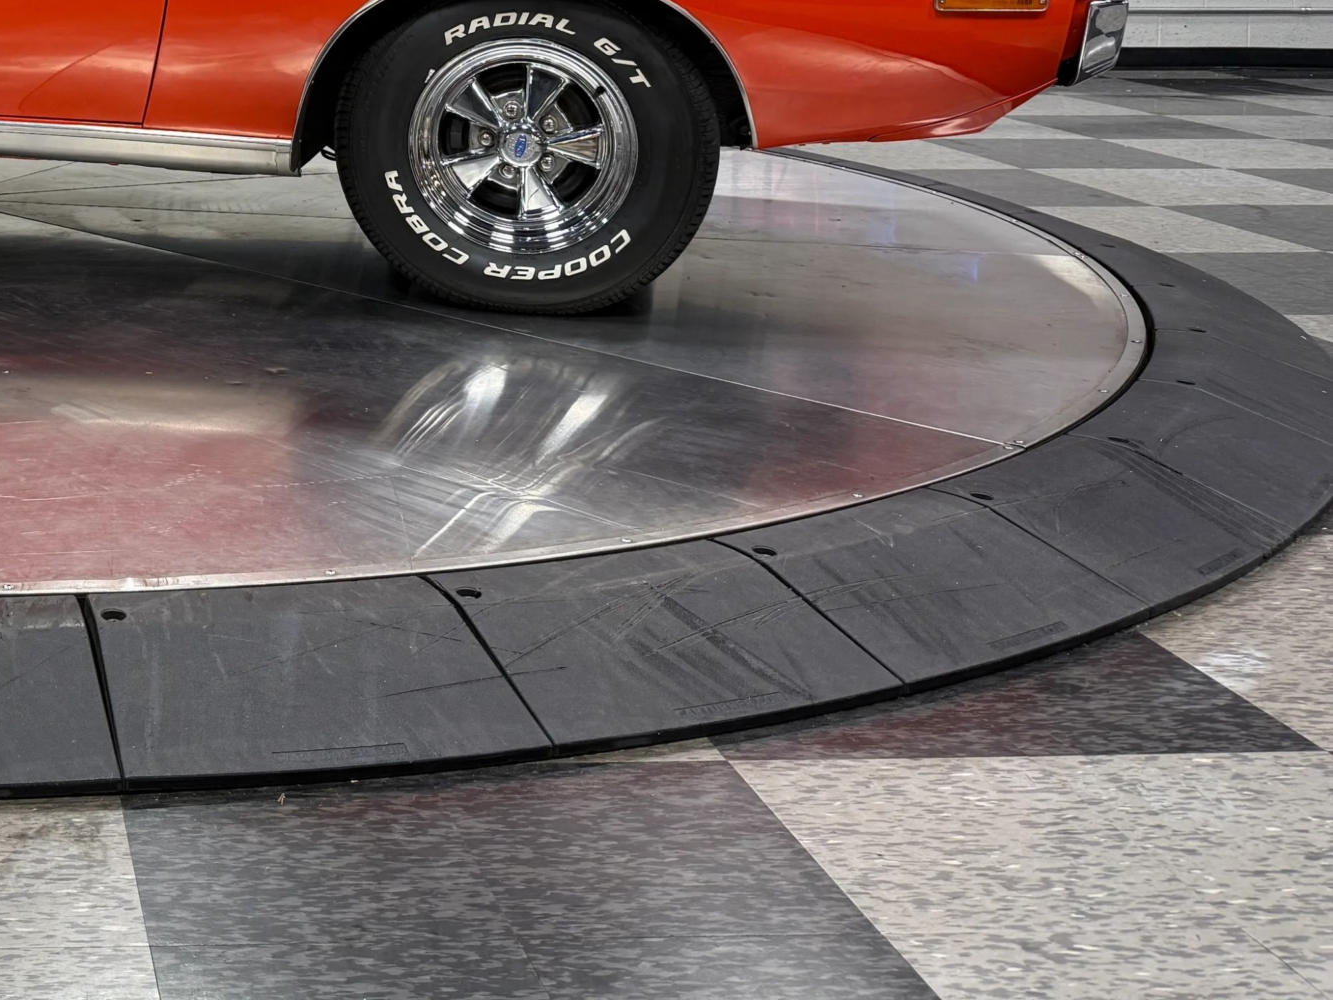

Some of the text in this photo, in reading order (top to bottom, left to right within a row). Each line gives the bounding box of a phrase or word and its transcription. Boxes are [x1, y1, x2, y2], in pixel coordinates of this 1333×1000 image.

[443, 11, 652, 89] RADIAL G/T
[384, 170, 632, 281] COOPER COBRA
